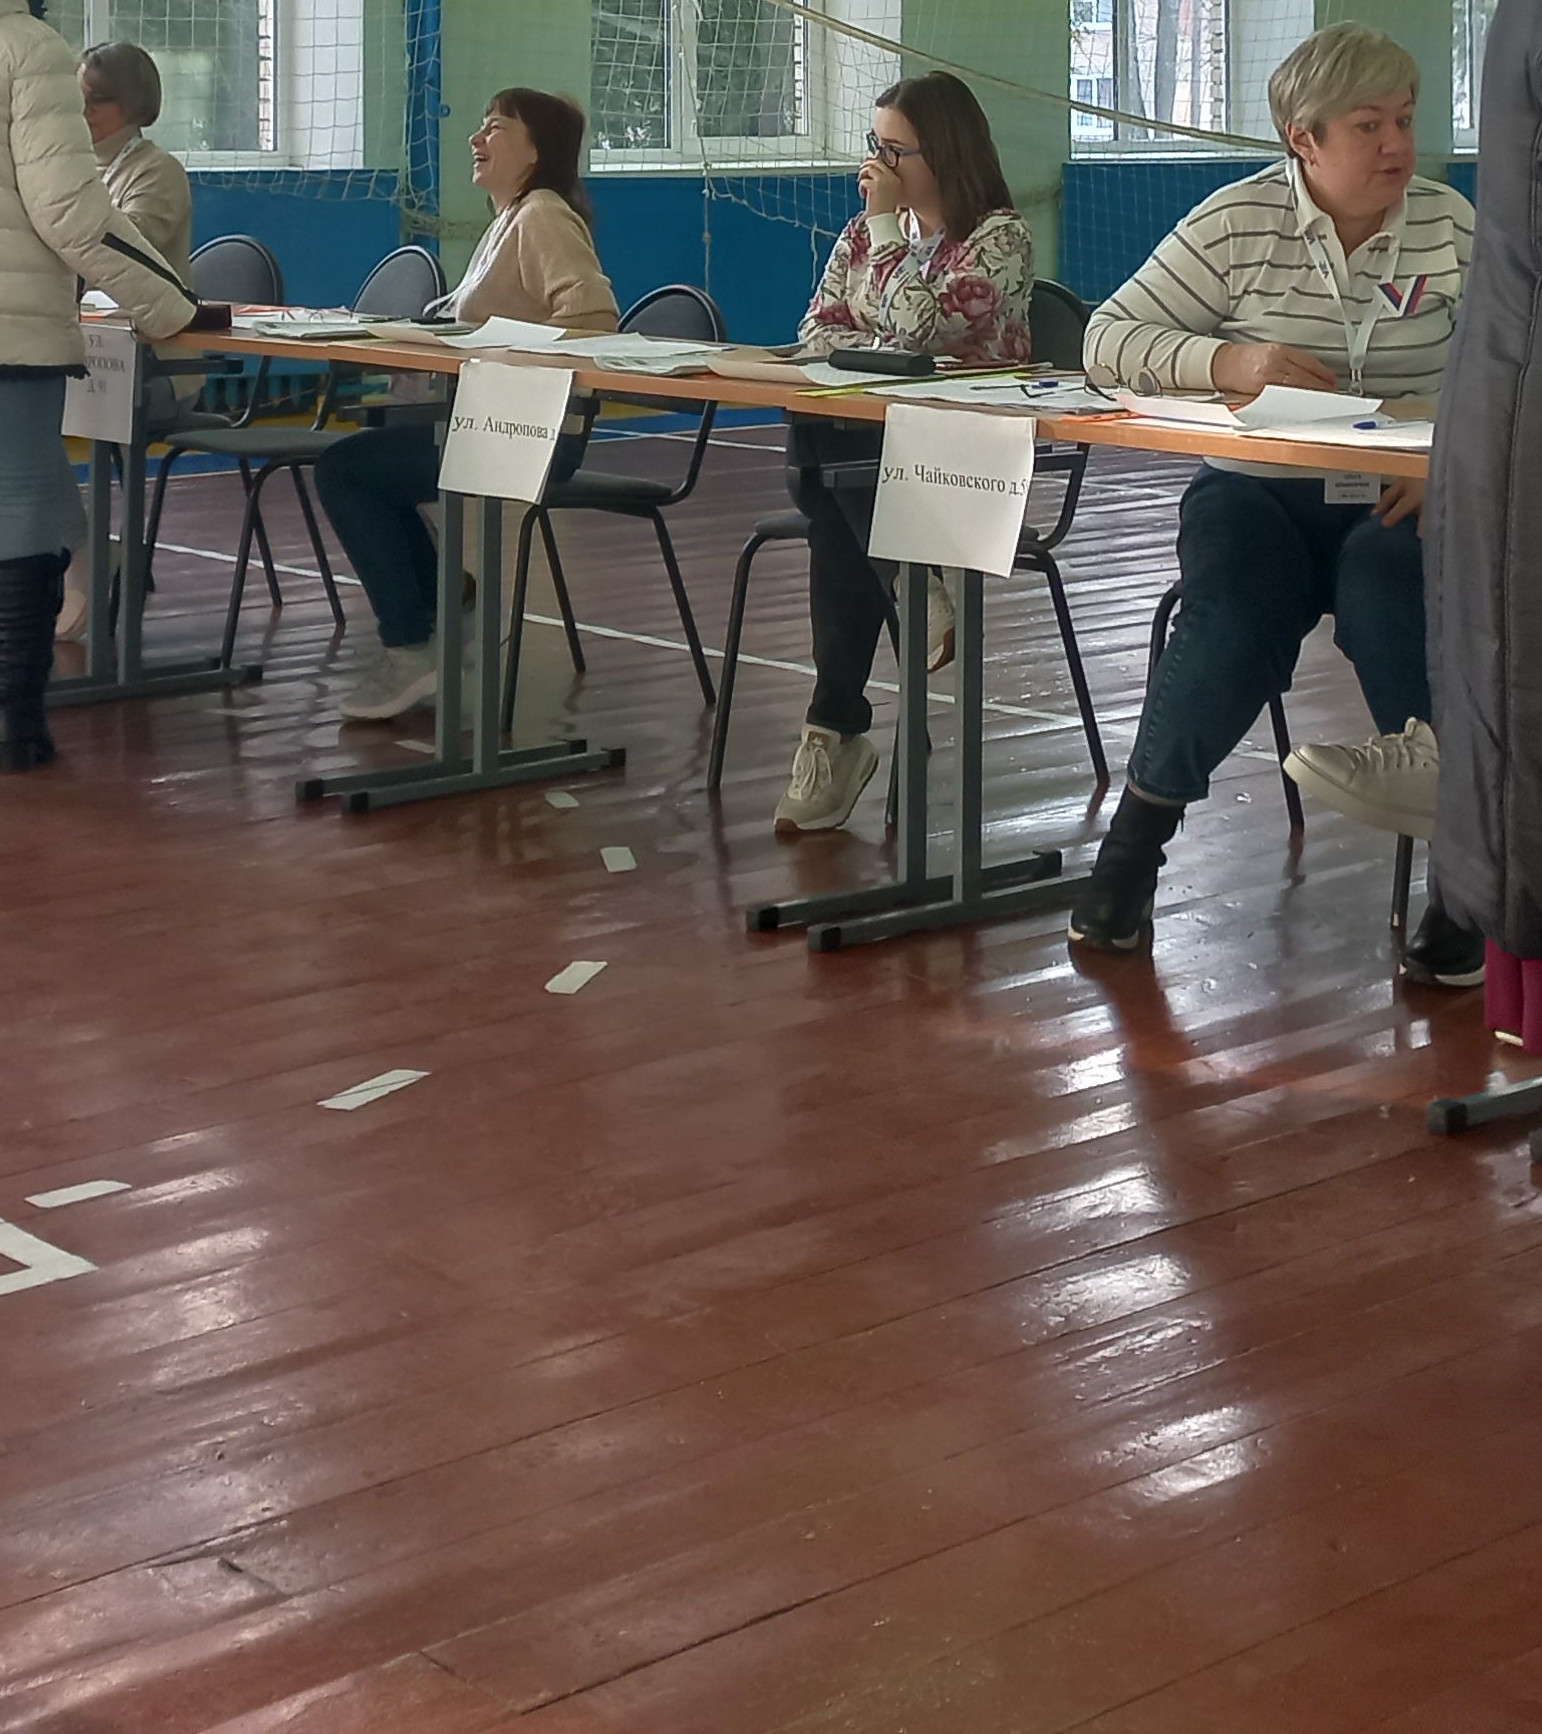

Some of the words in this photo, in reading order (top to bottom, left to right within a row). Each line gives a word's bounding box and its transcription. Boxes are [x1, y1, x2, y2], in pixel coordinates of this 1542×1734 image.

[451, 416, 478, 432] ул.
[482, 416, 548, 439] Андропова
[881, 466, 909, 484] ул.
[914, 464, 1006, 493] Чайковского
